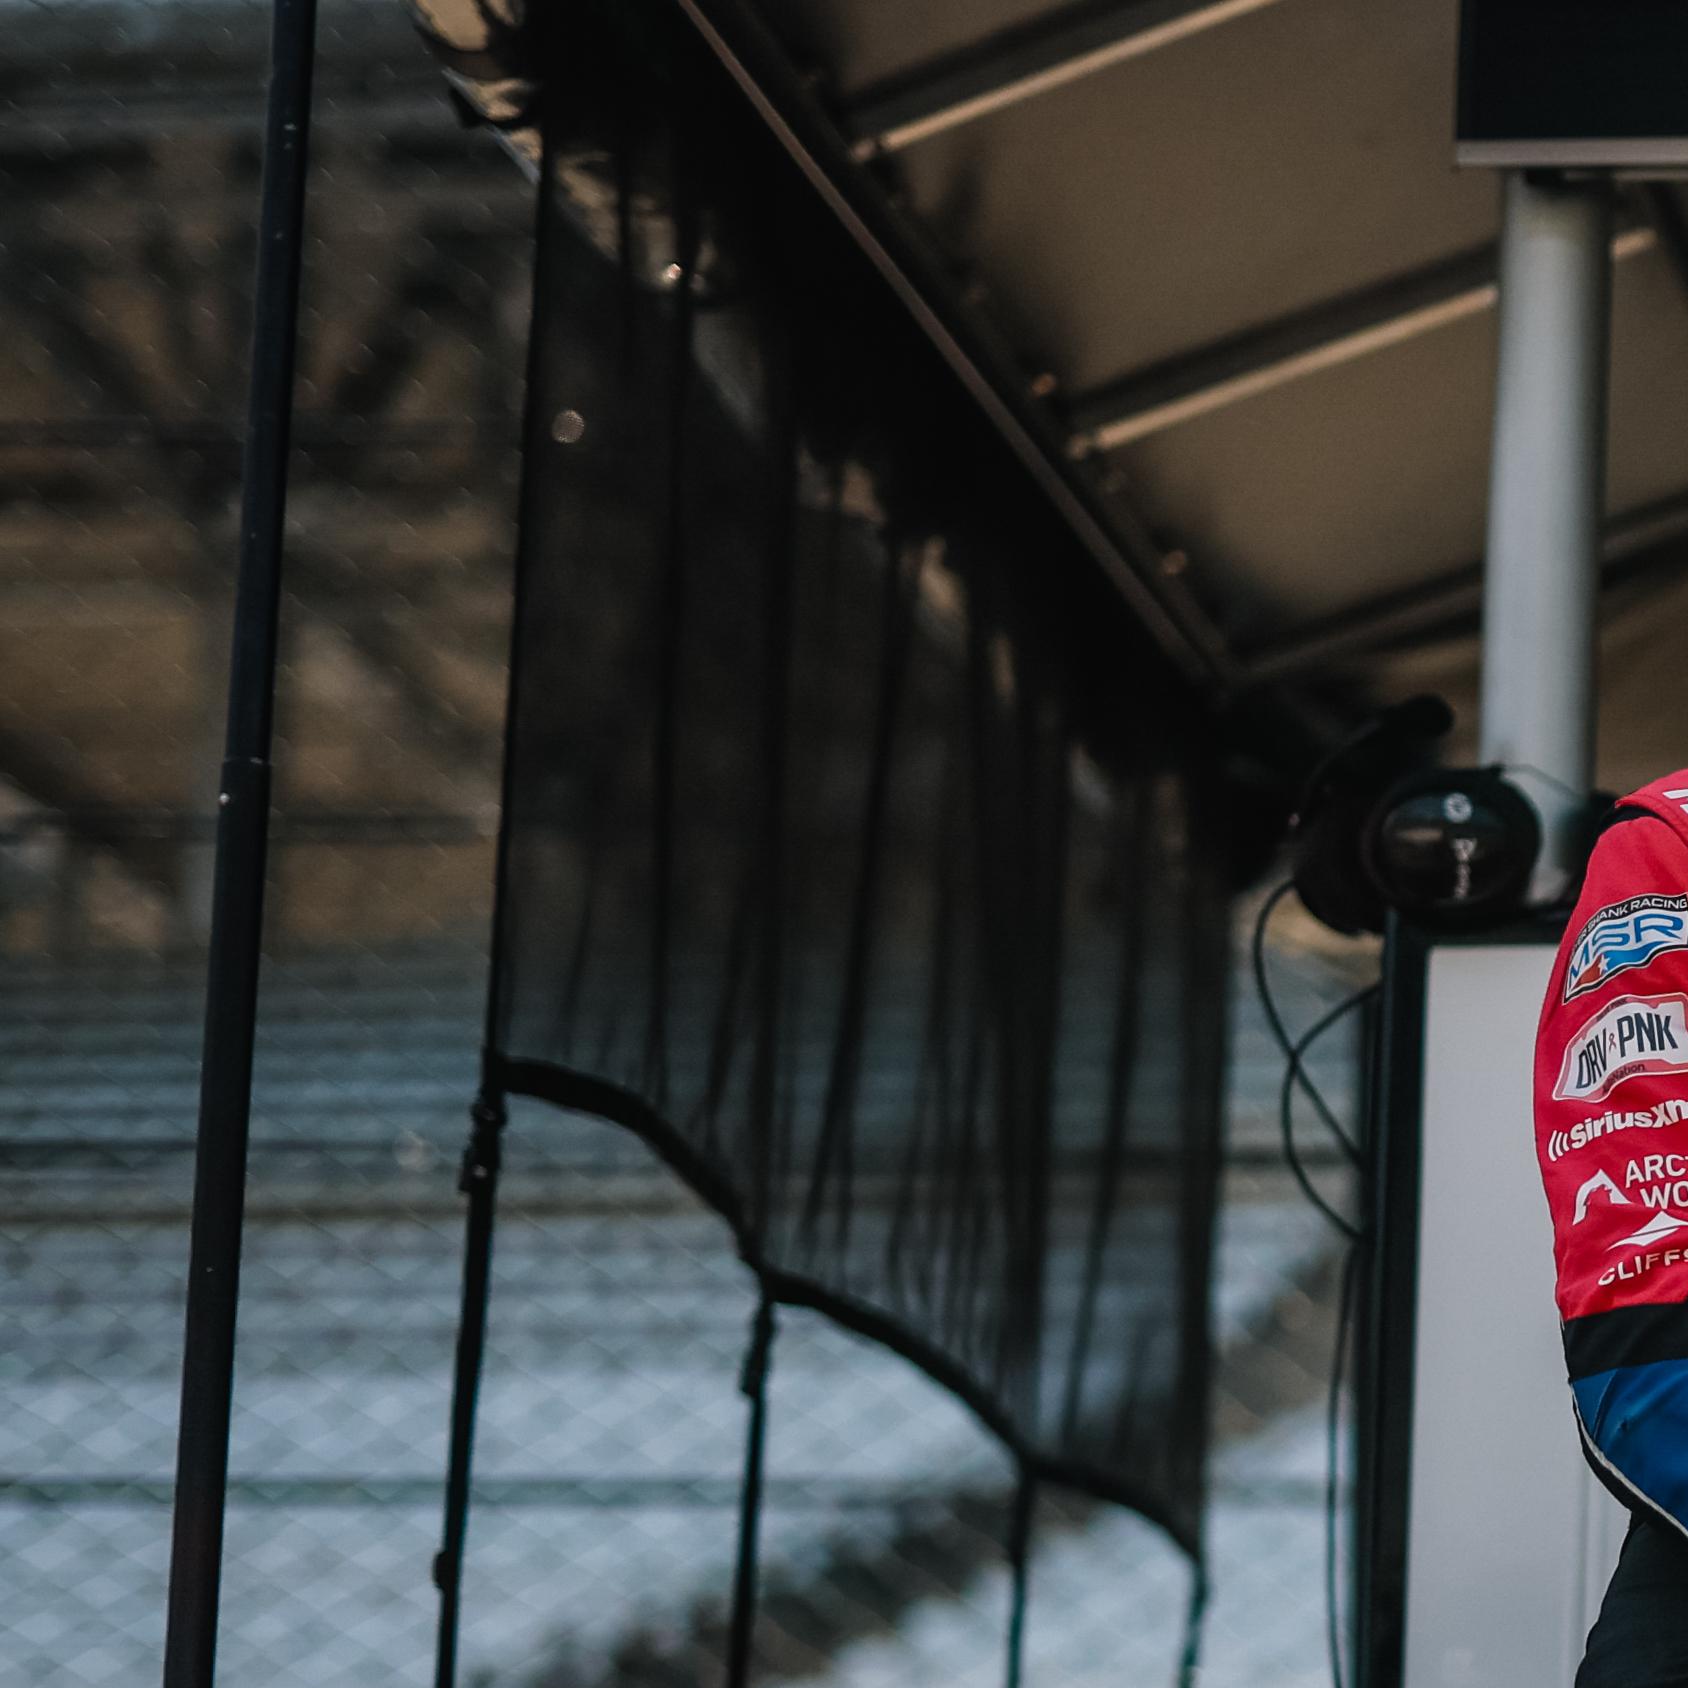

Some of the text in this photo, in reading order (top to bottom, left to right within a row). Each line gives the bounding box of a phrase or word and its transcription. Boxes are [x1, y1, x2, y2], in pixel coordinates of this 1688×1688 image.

[1568, 913, 1684, 991] MSR
[1587, 898, 1688, 933] SHANK RACING
[1576, 1012, 1679, 1089] DRV PNK
